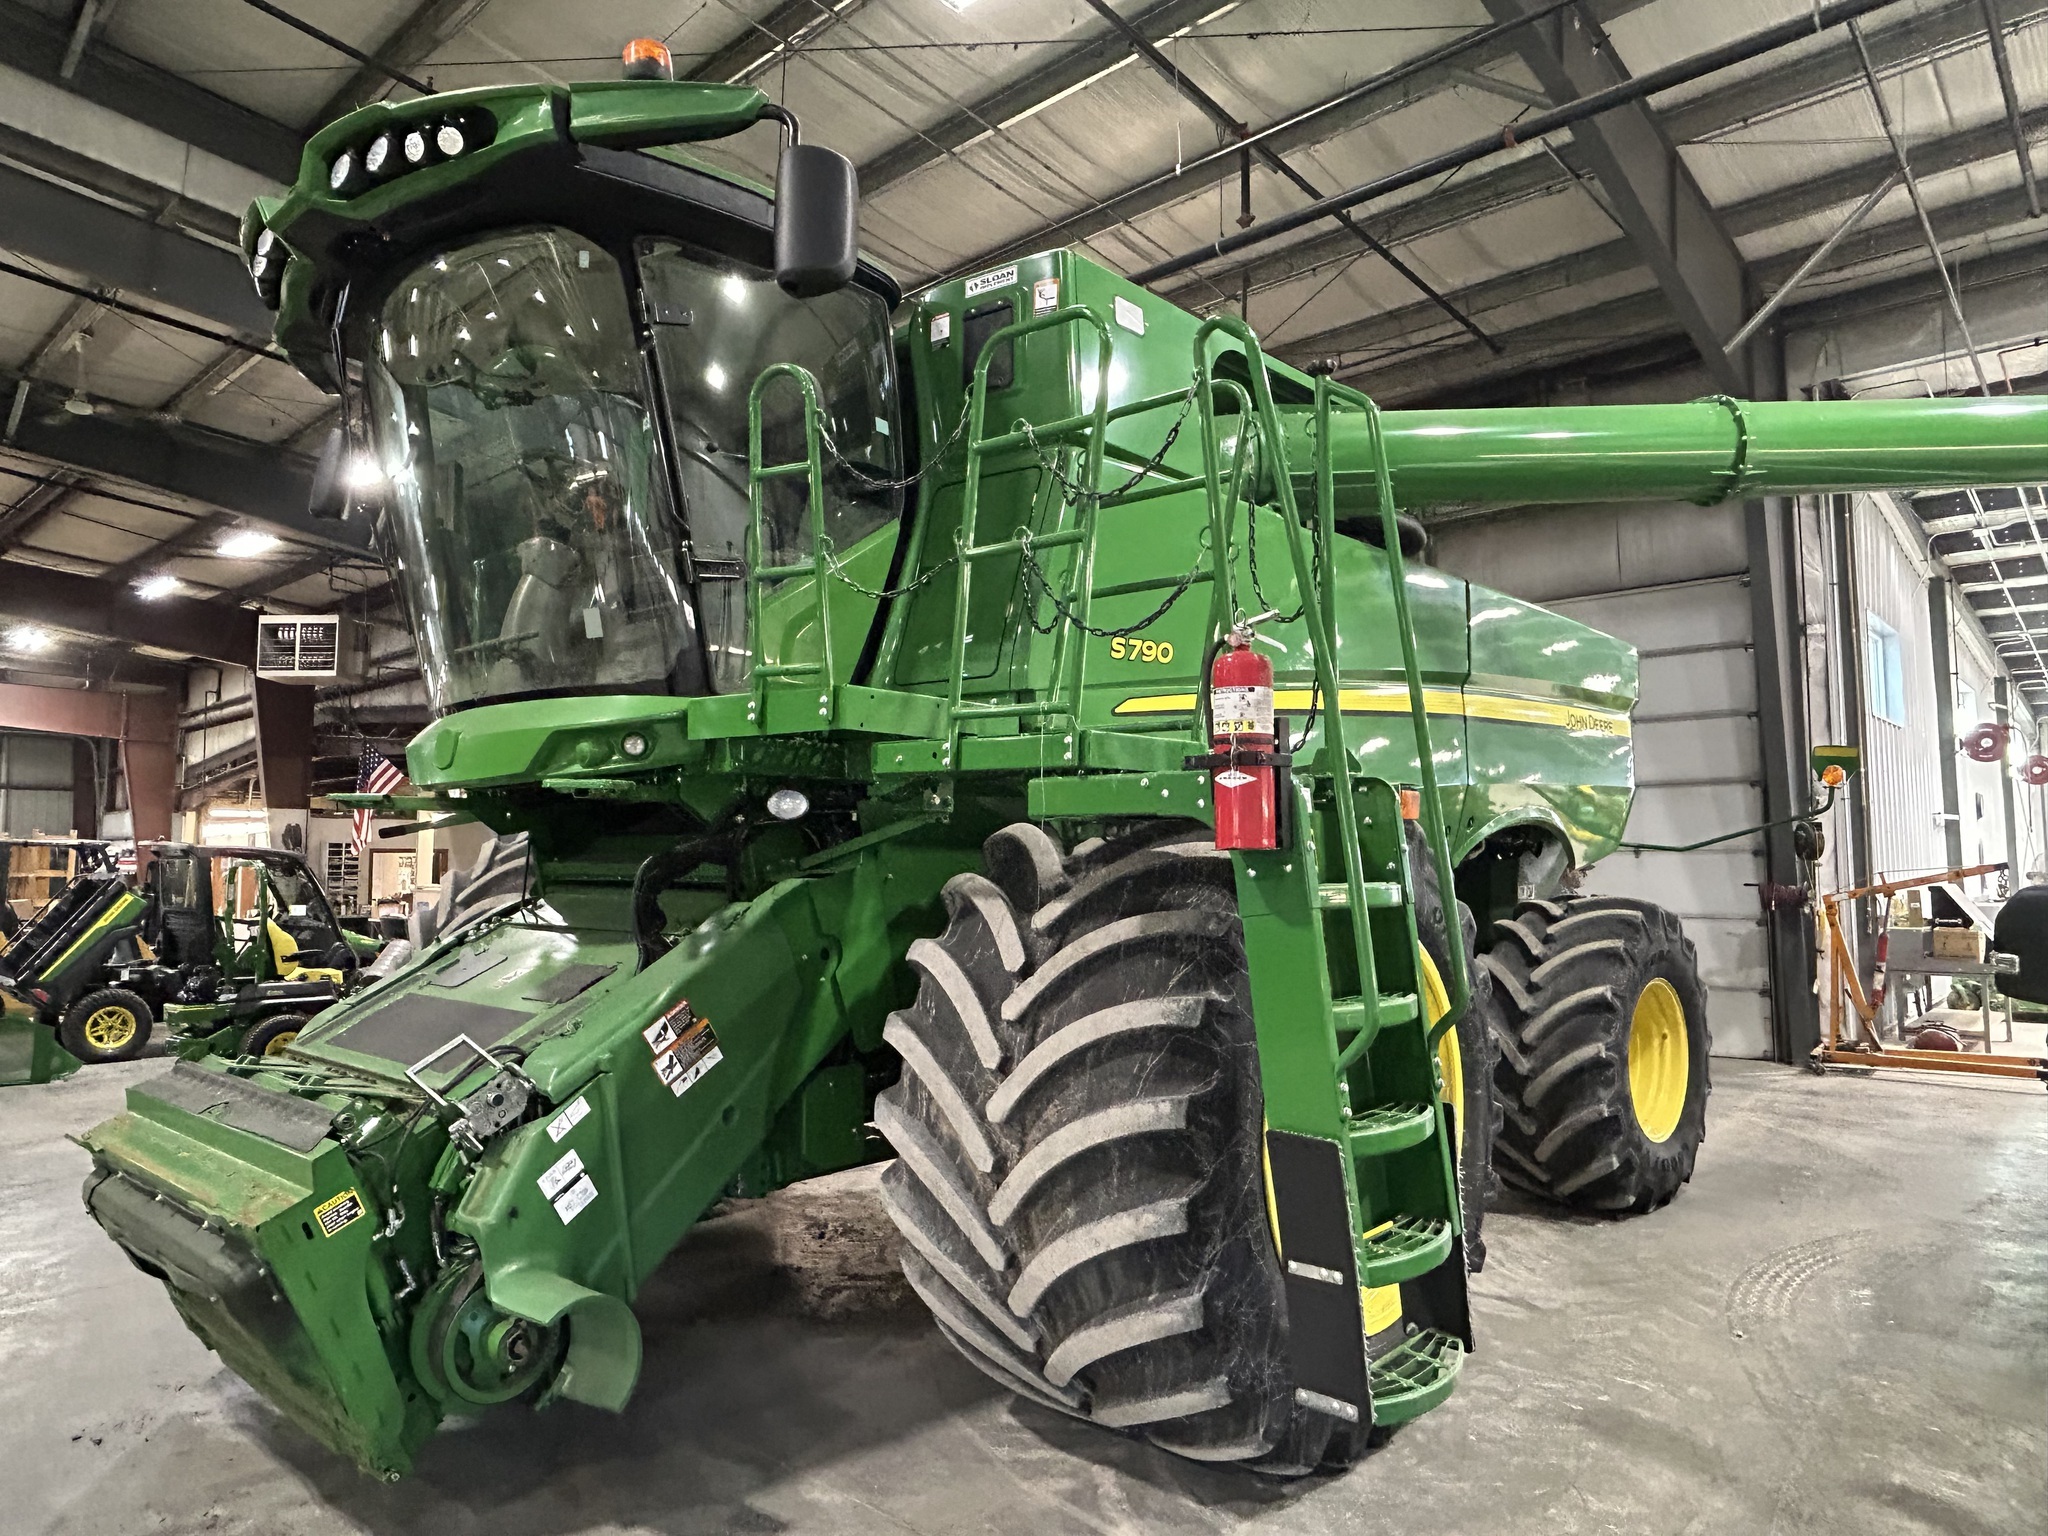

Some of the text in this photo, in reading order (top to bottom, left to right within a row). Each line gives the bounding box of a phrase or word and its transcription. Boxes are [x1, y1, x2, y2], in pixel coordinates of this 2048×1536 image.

[980, 270, 1014, 285] SLOAN
[1110, 634, 1174, 664] S790
[1566, 710, 1613, 734] JOHN DEERE
[321, 1189, 355, 1212] CAUTION
